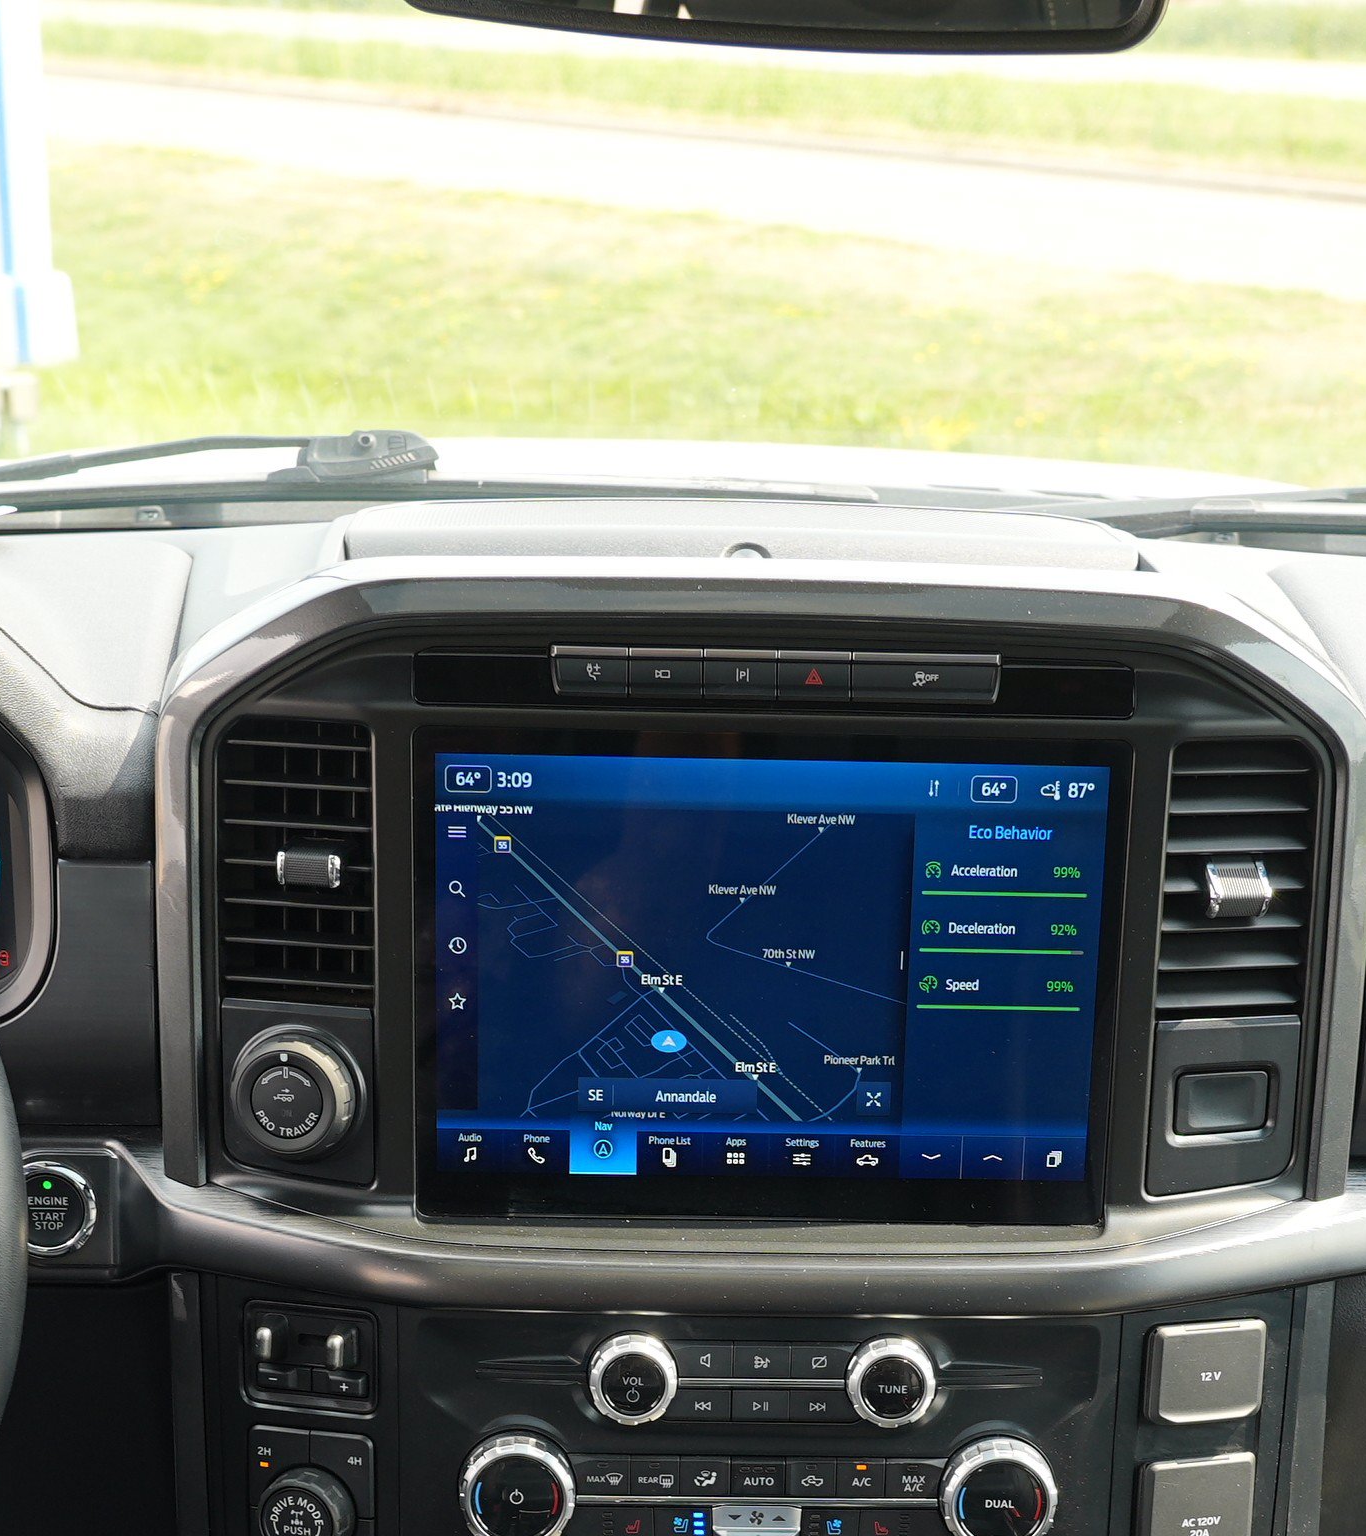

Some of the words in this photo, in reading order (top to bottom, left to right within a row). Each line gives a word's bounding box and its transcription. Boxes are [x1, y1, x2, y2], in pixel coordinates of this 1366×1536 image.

[925, 673, 939, 682] OFF
[455, 771, 481, 787] 64°
[497, 772, 532, 788] 3:09
[981, 782, 1007, 797] 64°
[1068, 783, 1096, 799] 87°
[514, 806, 533, 815] NW
[787, 814, 817, 825] Klever
[818, 815, 837, 825] Ave
[838, 815, 856, 825] NW
[968, 825, 992, 840] Eco
[995, 825, 1053, 841] Behavior
[951, 864, 1018, 877] Acceleration
[1053, 866, 1081, 878] 99%
[708, 884, 739, 895] Klever
[739, 885, 758, 895] Ave
[759, 886, 776, 895] NW
[948, 922, 1016, 935] Deceleration
[1050, 924, 1077, 936] 92%
[762, 948, 785, 959] 70th
[786, 949, 797, 959] St
[798, 950, 815, 959] NW
[620, 956, 630, 964] 55
[641, 974, 662, 985] Elm
[663, 975, 674, 985] St
[675, 975, 683, 986] E
[945, 979, 979, 992] Speed
[1047, 981, 1074, 992] 99%
[824, 1055, 858, 1065] Pioneer
[860, 1055, 881, 1065] Park
[882, 1055, 895, 1066] Trl
[735, 1062, 756, 1073] Elm
[756, 1062, 768, 1073] St
[769, 1063, 776, 1073] E
[588, 1089, 604, 1101] SE
[655, 1090, 716, 1103] Annandale
[255, 1110, 276, 1132] PRO
[279, 1111, 319, 1137] TRAILER
[594, 1121, 613, 1131] Nav
[458, 1133, 482, 1143] Audio
[523, 1134, 550, 1144] Phone
[648, 1136, 675, 1146] Phone
[676, 1137, 691, 1146] List
[726, 1137, 746, 1147] Apps
[785, 1138, 820, 1149] Settings
[850, 1139, 886, 1148] Features
[27, 1196, 69, 1206] ENGINE
[32, 1212, 65, 1221] START
[35, 1222, 64, 1230] STOP
[622, 1377, 644, 1386] VOL
[1200, 1371, 1212, 1382] 12
[1213, 1371, 1222, 1381] V
[878, 1384, 908, 1395] TUNE
[257, 1446, 271, 1456] 2H
[347, 1456, 362, 1466] 4H
[586, 1474, 606, 1484] MAX
[638, 1475, 659, 1484] REAR
[743, 1477, 774, 1487] AUTO
[852, 1477, 872, 1487] A/C
[902, 1475, 925, 1484] MAX
[904, 1484, 923, 1493] A/C
[985, 1499, 1014, 1509] DUAL
[270, 1496, 295, 1523] DRIVE
[296, 1496, 324, 1526] MODE
[1182, 1517, 1196, 1528] AC
[1197, 1516, 1221, 1527] 120V
[283, 1525, 311, 1536] PUSH
